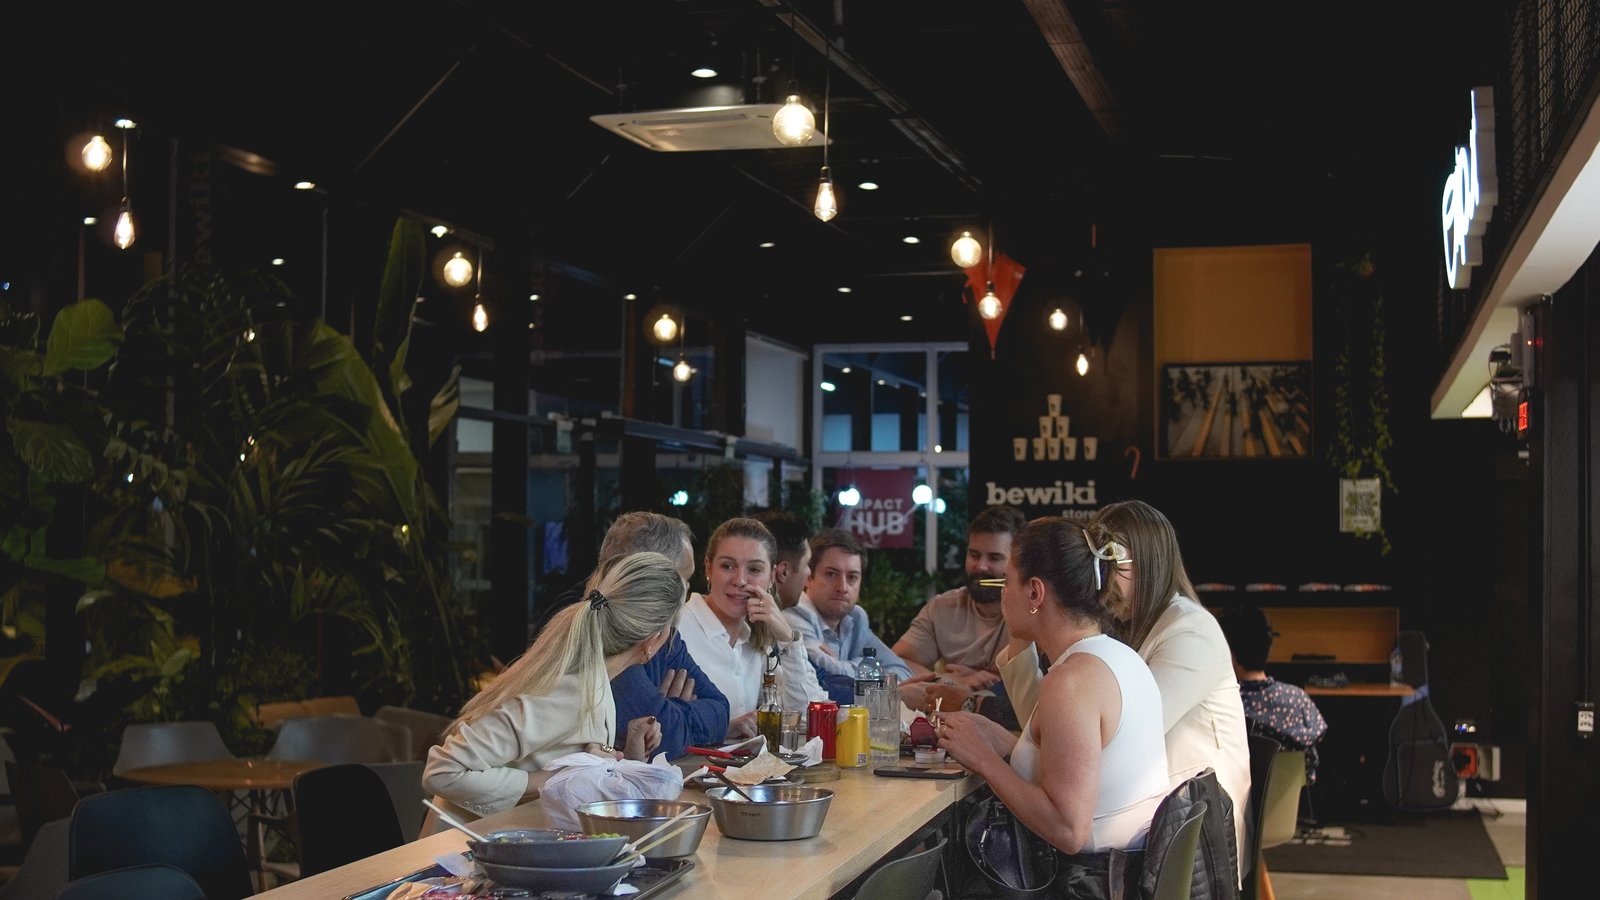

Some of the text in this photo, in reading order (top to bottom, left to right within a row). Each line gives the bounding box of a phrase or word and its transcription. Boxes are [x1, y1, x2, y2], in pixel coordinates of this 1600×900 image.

[854, 498, 904, 510] PACT
[986, 480, 1097, 505] bewiki
[844, 511, 905, 535] HUB
